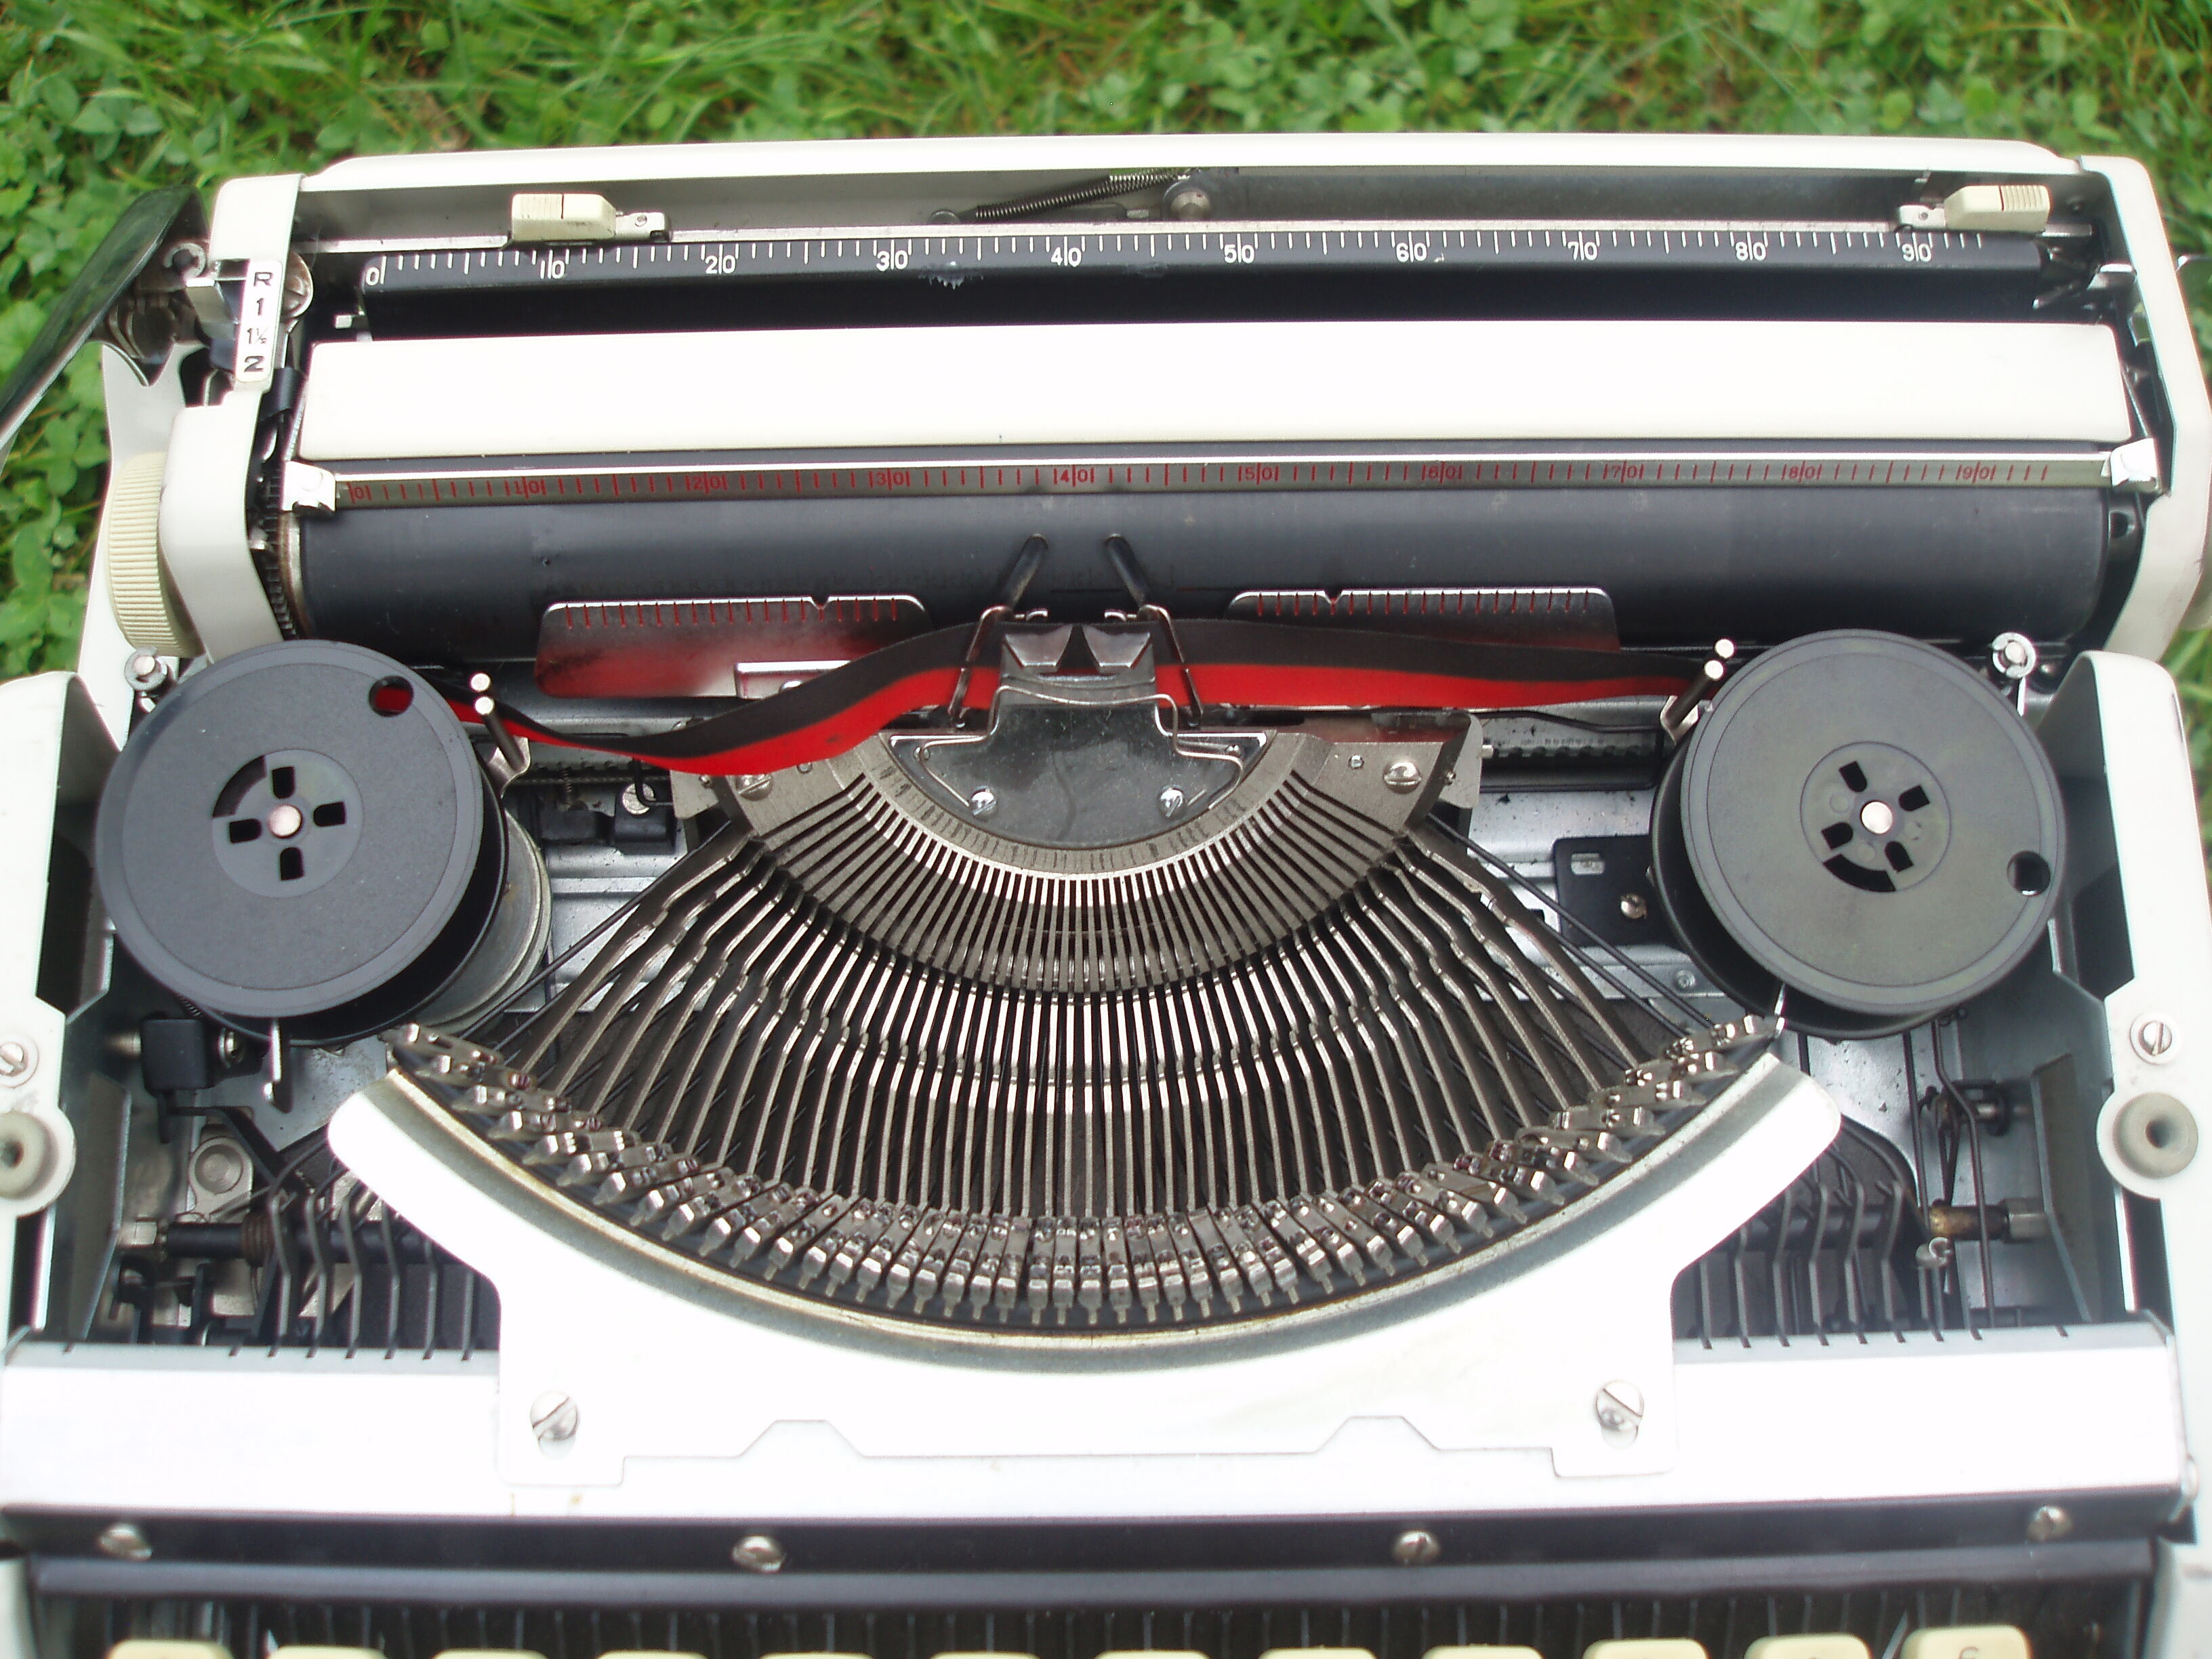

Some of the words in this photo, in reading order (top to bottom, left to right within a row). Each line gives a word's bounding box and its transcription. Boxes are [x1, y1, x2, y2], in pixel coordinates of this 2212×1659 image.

[253, 272, 273, 287] R
[256, 298, 264, 316] 1
[244, 356, 265, 373] 2
